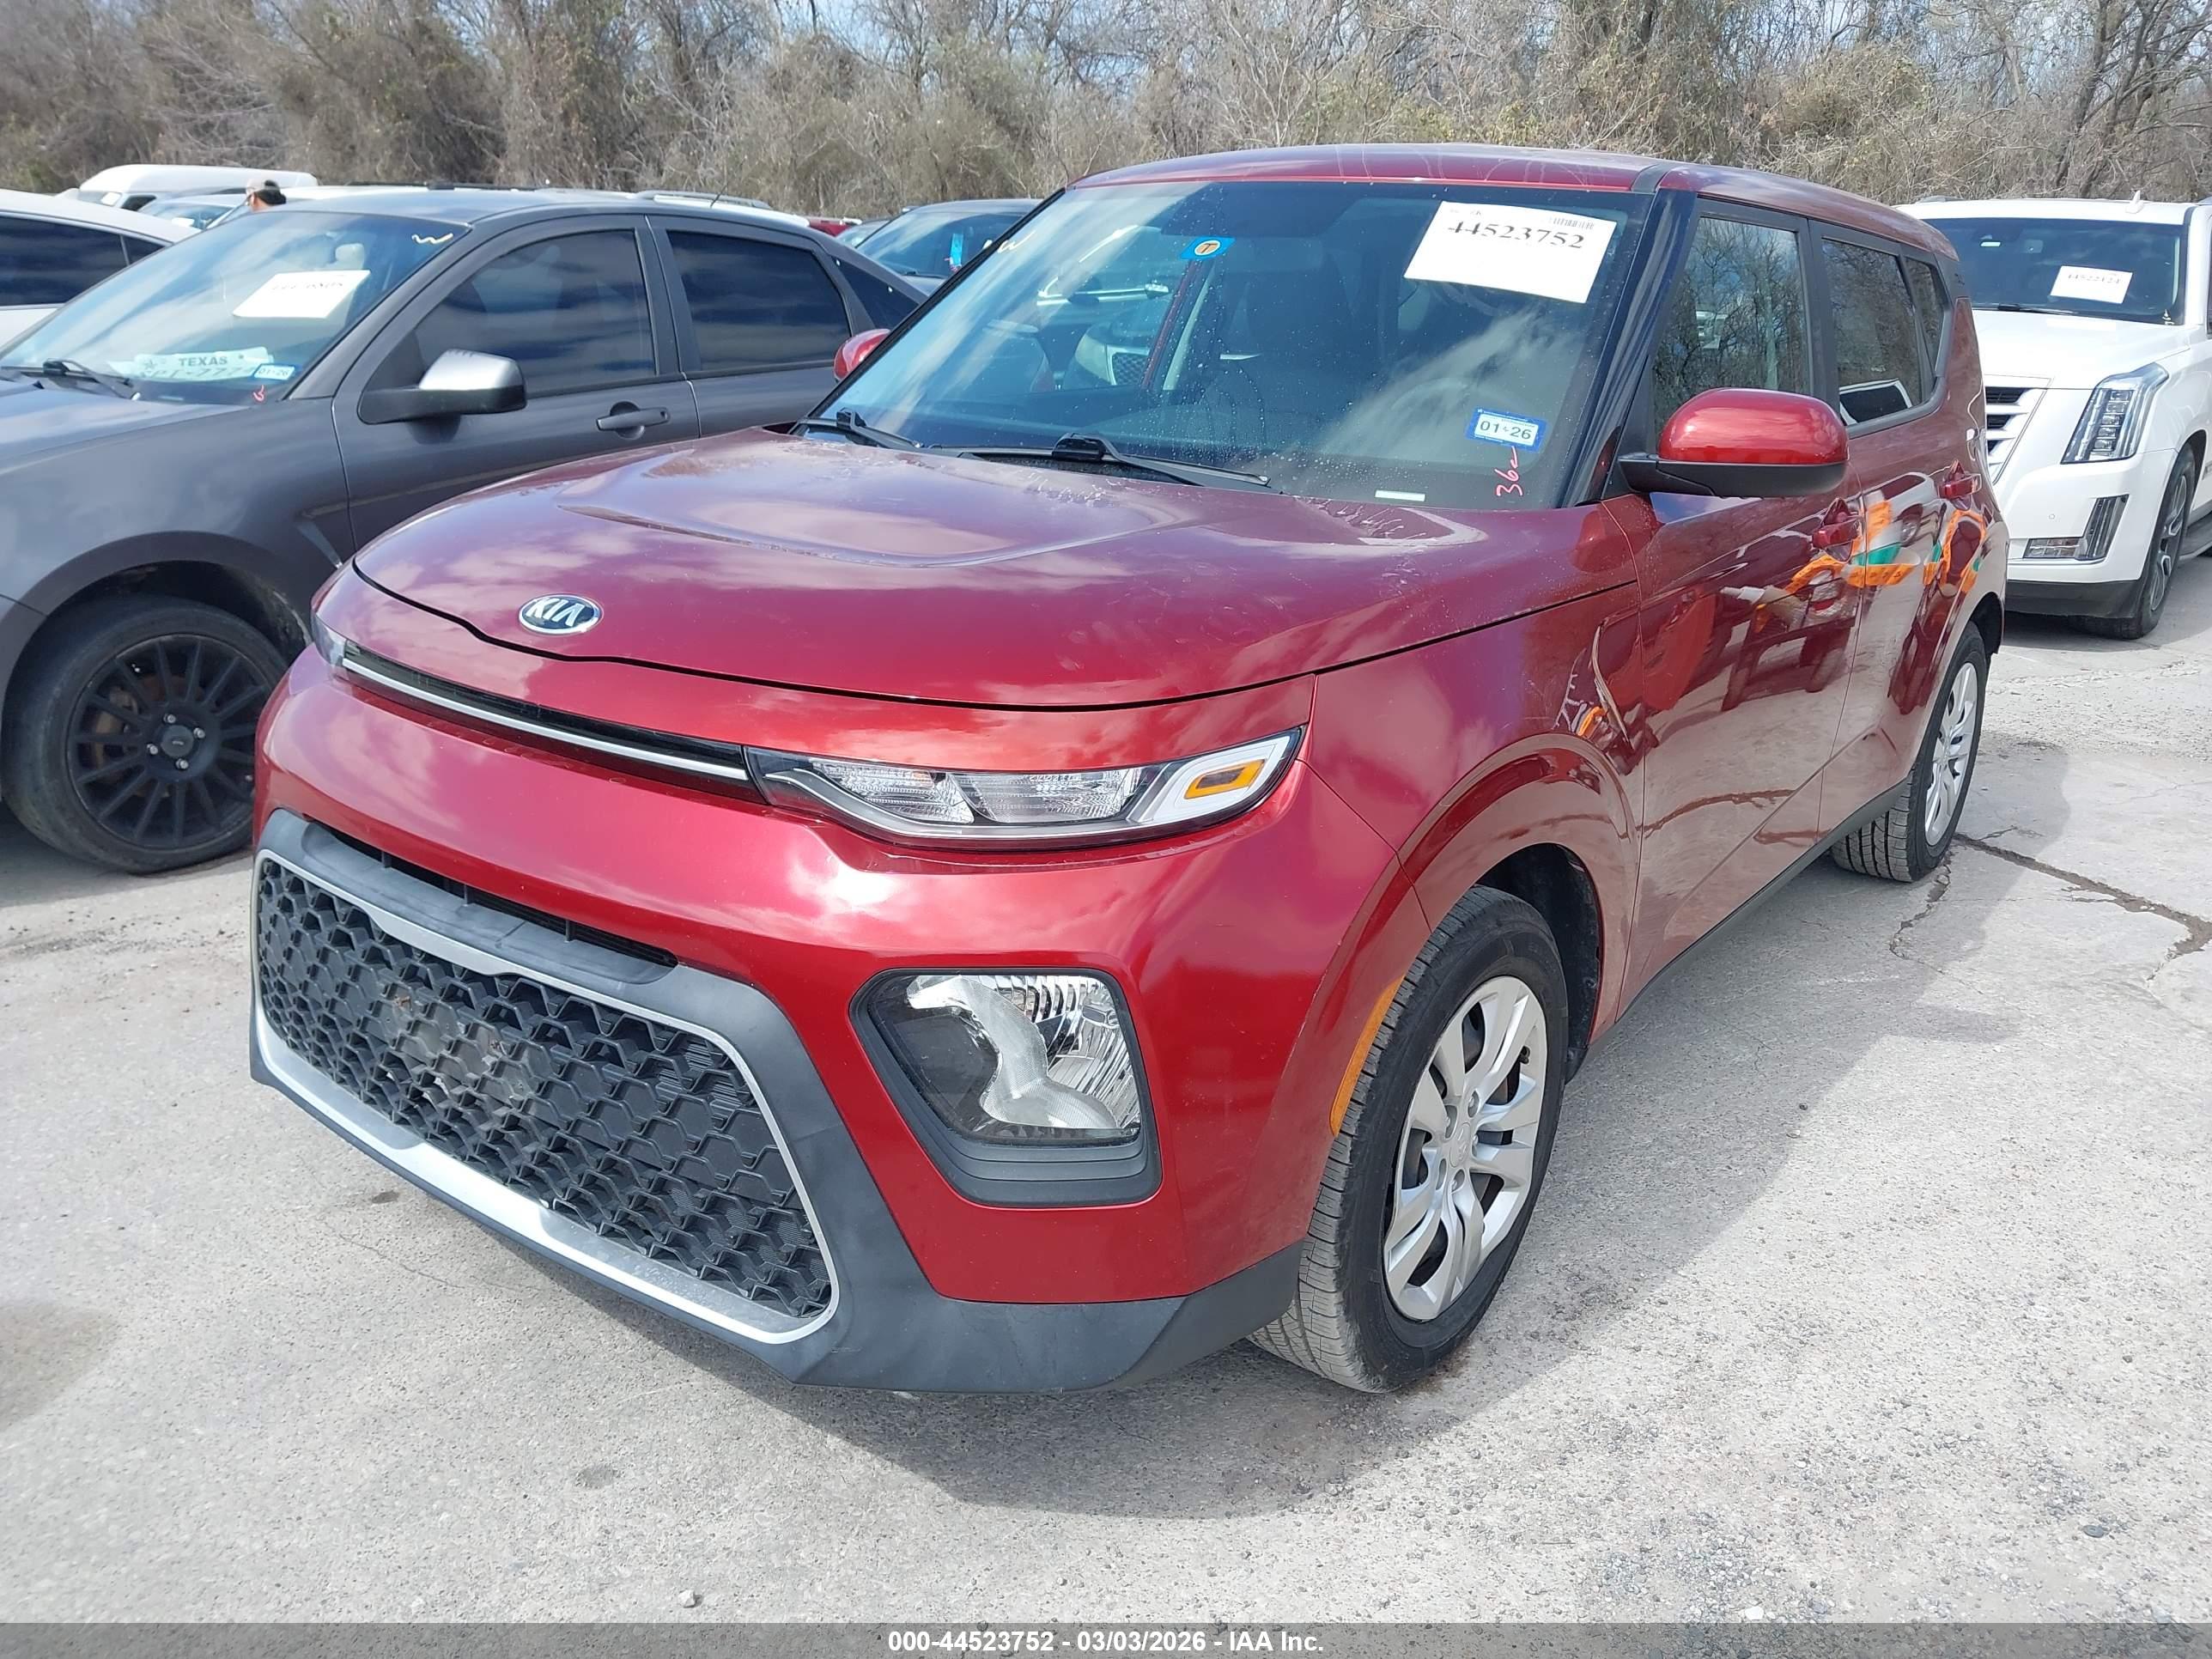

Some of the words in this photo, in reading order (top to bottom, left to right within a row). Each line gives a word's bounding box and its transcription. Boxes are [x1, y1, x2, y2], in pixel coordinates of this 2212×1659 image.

[1447, 220, 1585, 249] 44523752
[178, 356, 228, 367] TEXAS
[526, 597, 586, 627] KIA
